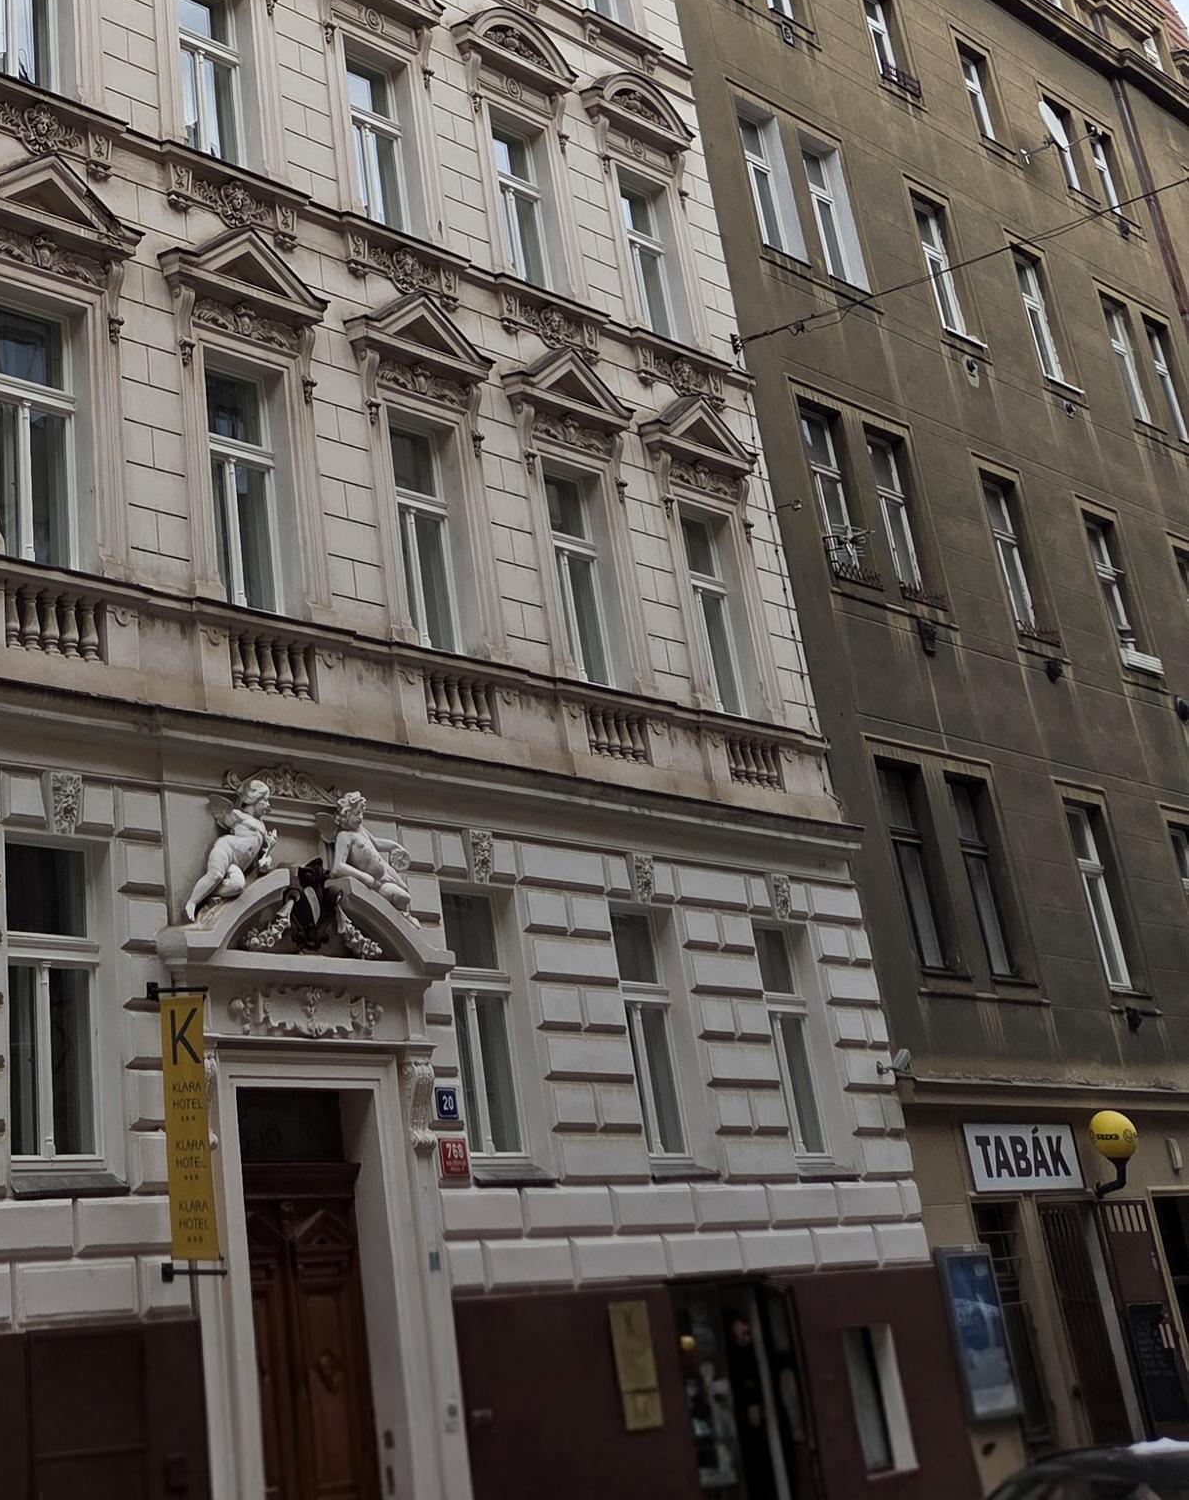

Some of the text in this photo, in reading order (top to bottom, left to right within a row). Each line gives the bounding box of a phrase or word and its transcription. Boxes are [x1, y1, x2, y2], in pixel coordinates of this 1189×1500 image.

[169, 1007, 202, 1066] K
[172, 1081, 202, 1093] KLARA
[172, 1098, 203, 1110] HOTEL
[442, 1095, 454, 1111] 20
[175, 1139, 205, 1151] KLARA
[445, 1143, 464, 1159] 768
[975, 1126, 1072, 1178] TABÁK
[178, 1200, 209, 1213] KLARA
[179, 1217, 209, 1230] HOTEL
